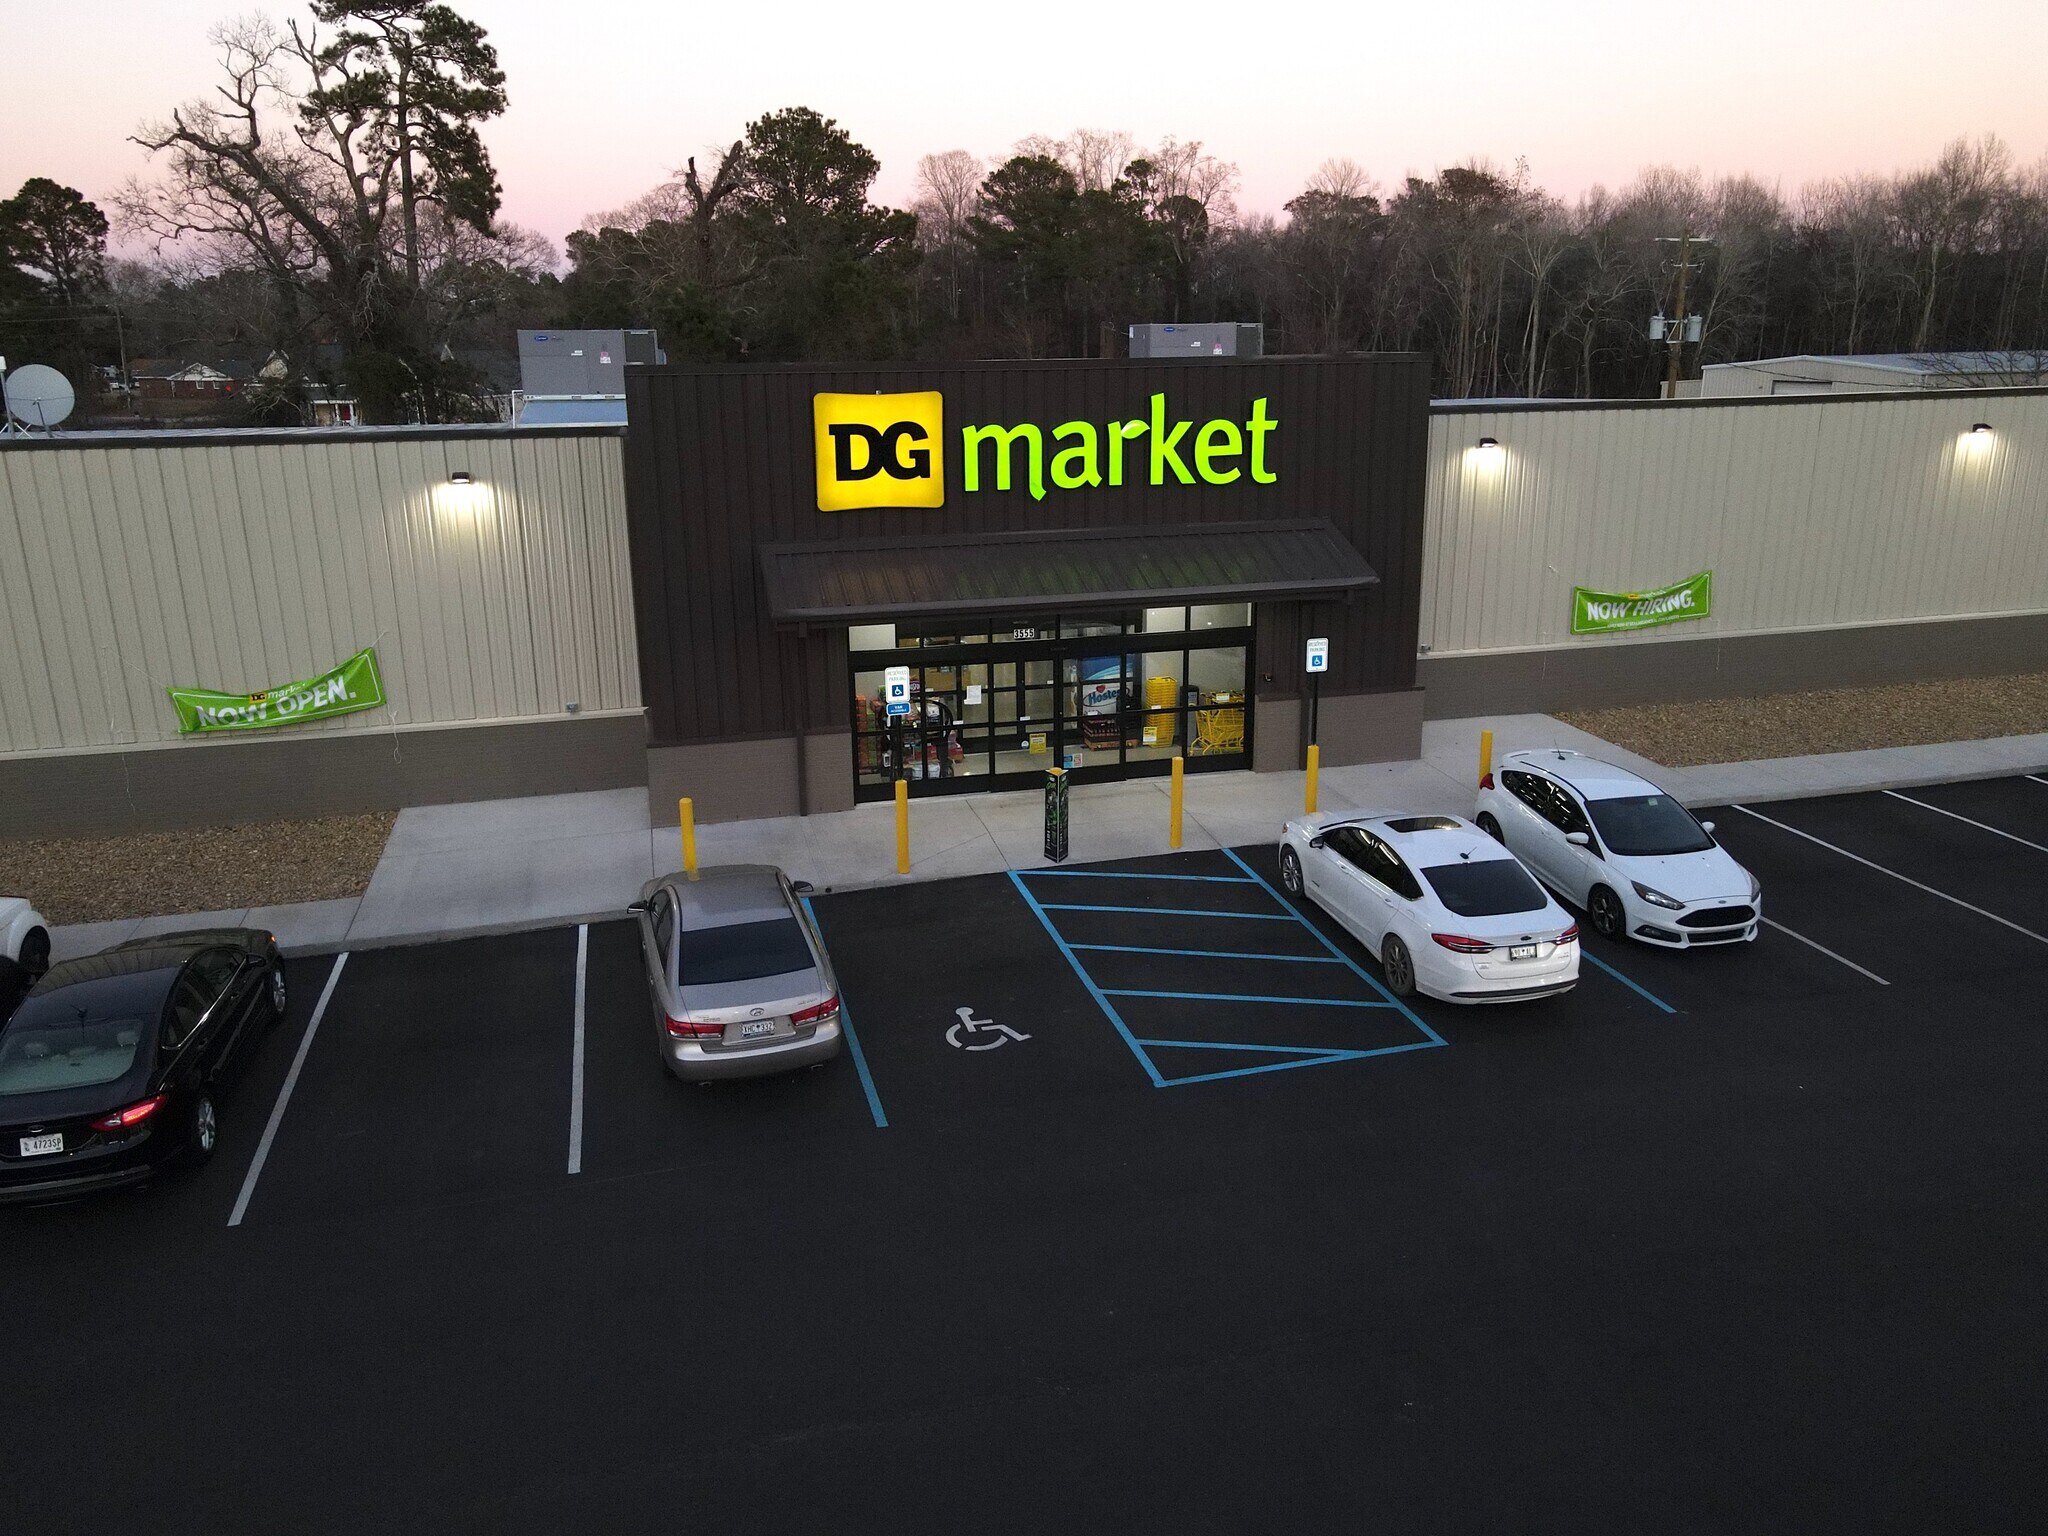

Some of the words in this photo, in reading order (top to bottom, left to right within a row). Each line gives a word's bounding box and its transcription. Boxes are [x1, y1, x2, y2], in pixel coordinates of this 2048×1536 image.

[828, 420, 931, 482] DG
[962, 392, 1279, 502] market
[1587, 601, 1632, 621] NOW
[1633, 589, 1695, 617] HIRING.
[1014, 628, 1034, 639] 3555
[195, 702, 268, 727] NOW
[276, 675, 356, 715] OPEN.
[251, 693, 265, 701] DG
[1087, 689, 1121, 706] Hostes
[33, 1138, 61, 1149] 4723SP
